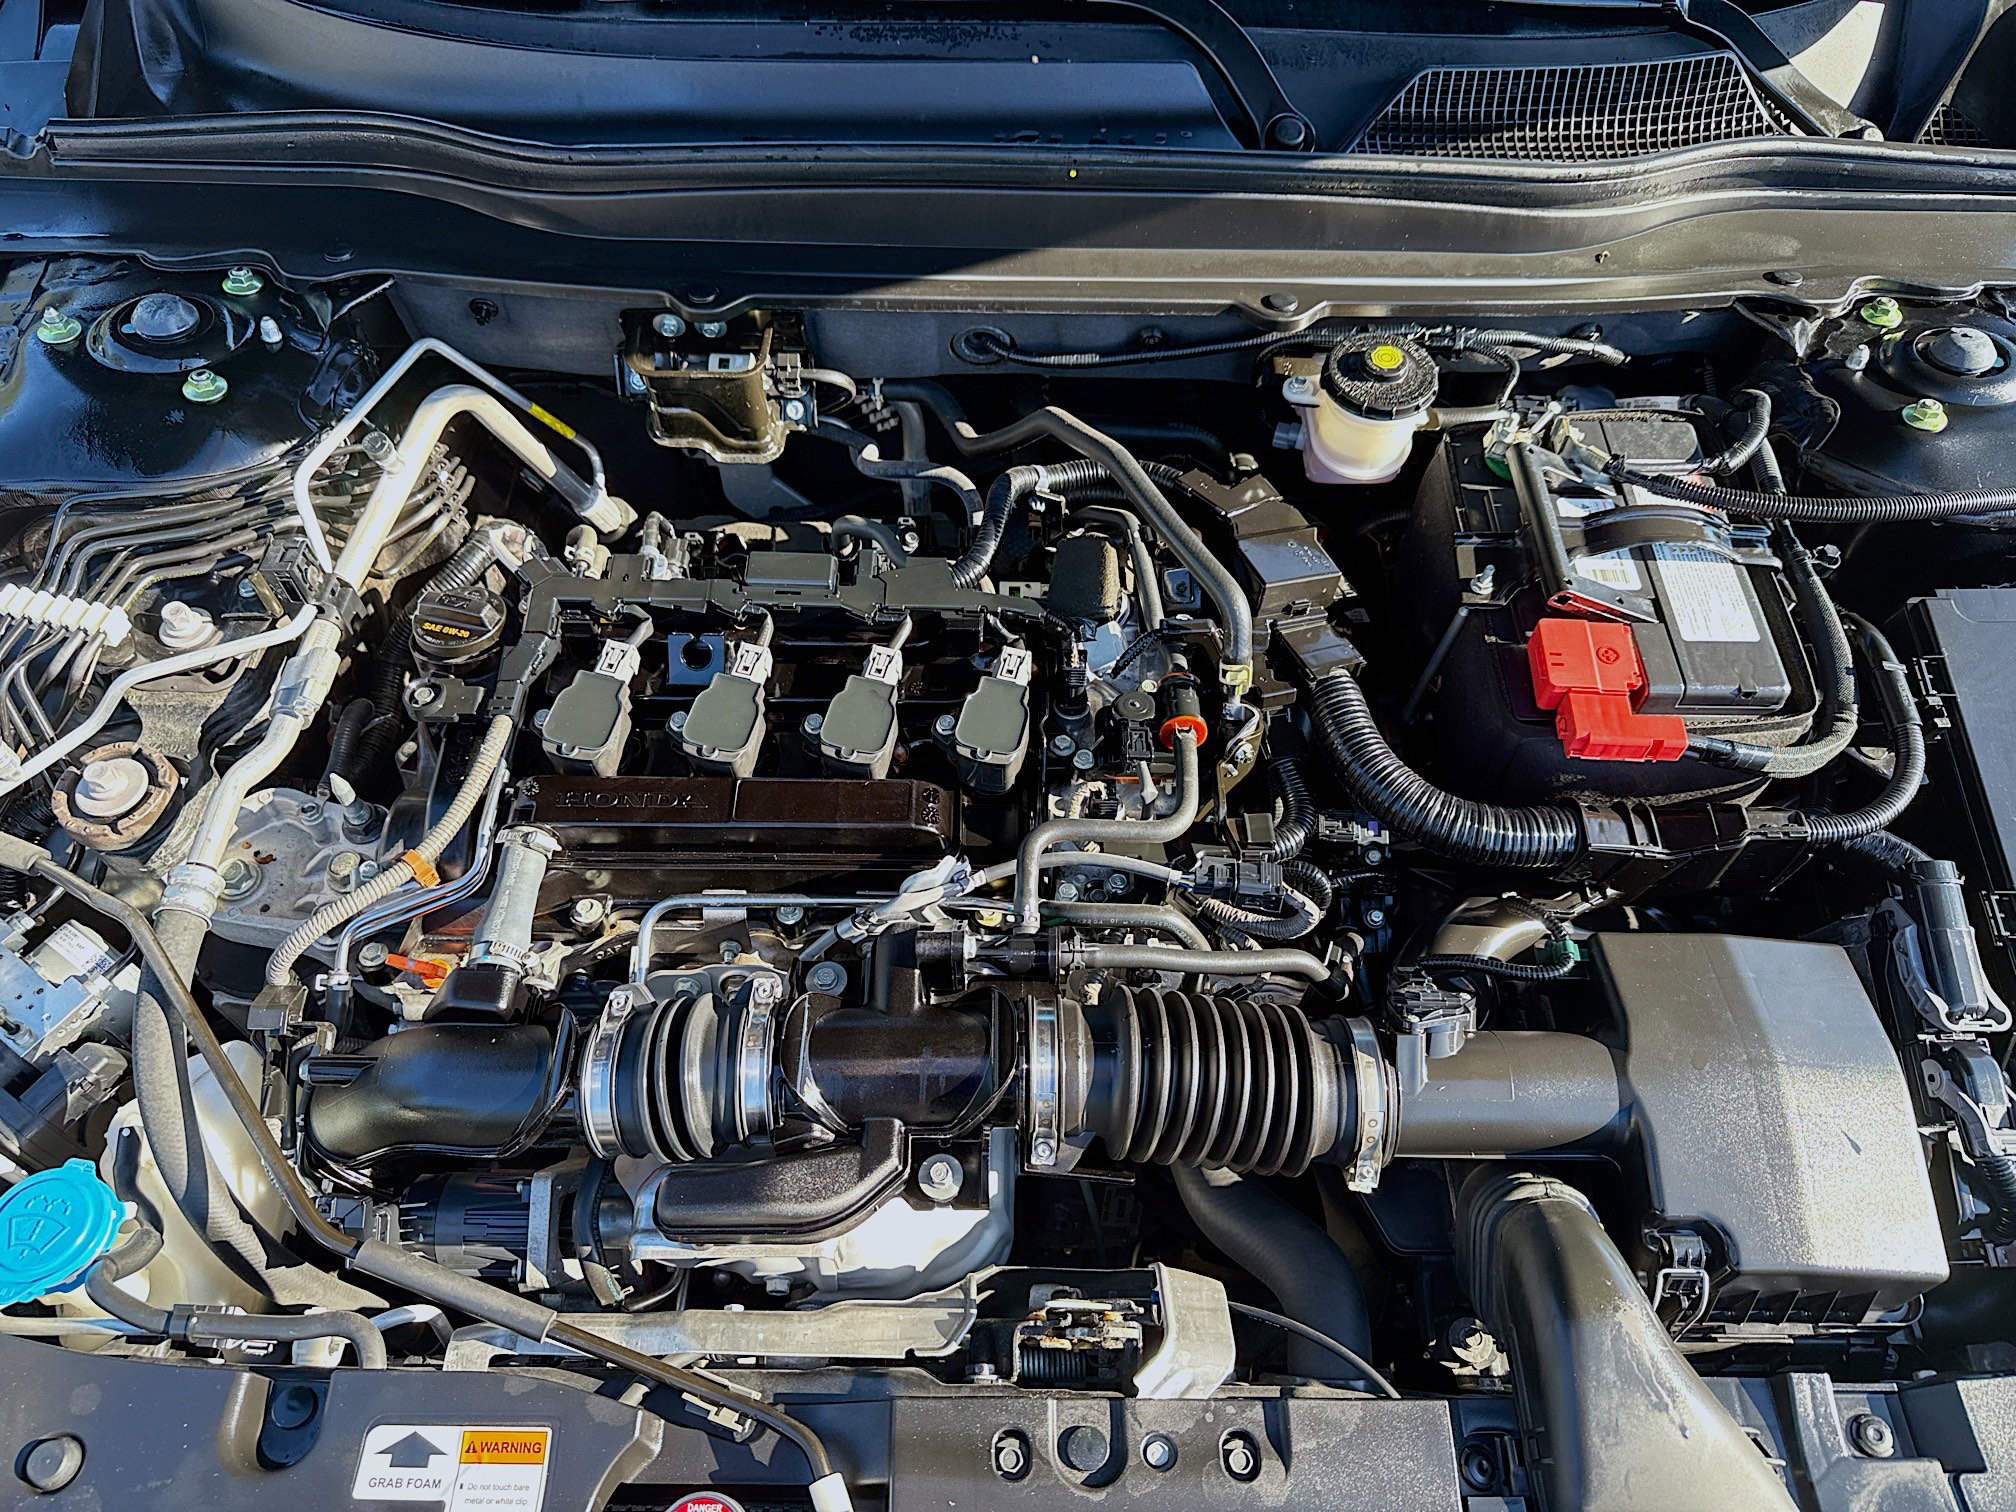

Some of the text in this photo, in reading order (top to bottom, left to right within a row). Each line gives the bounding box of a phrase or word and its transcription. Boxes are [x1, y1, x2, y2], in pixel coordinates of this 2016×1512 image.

[422, 622, 470, 638] SAE 0W-20
[555, 792, 709, 809] HONDA
[480, 1441, 542, 1454] WARNING
[368, 1477, 442, 1489] GRAB FOAM
[467, 1483, 530, 1492] Do not touch bare
[464, 1497, 484, 1505] metal
[495, 1497, 514, 1505] white
[687, 1503, 723, 1512] DANGER
